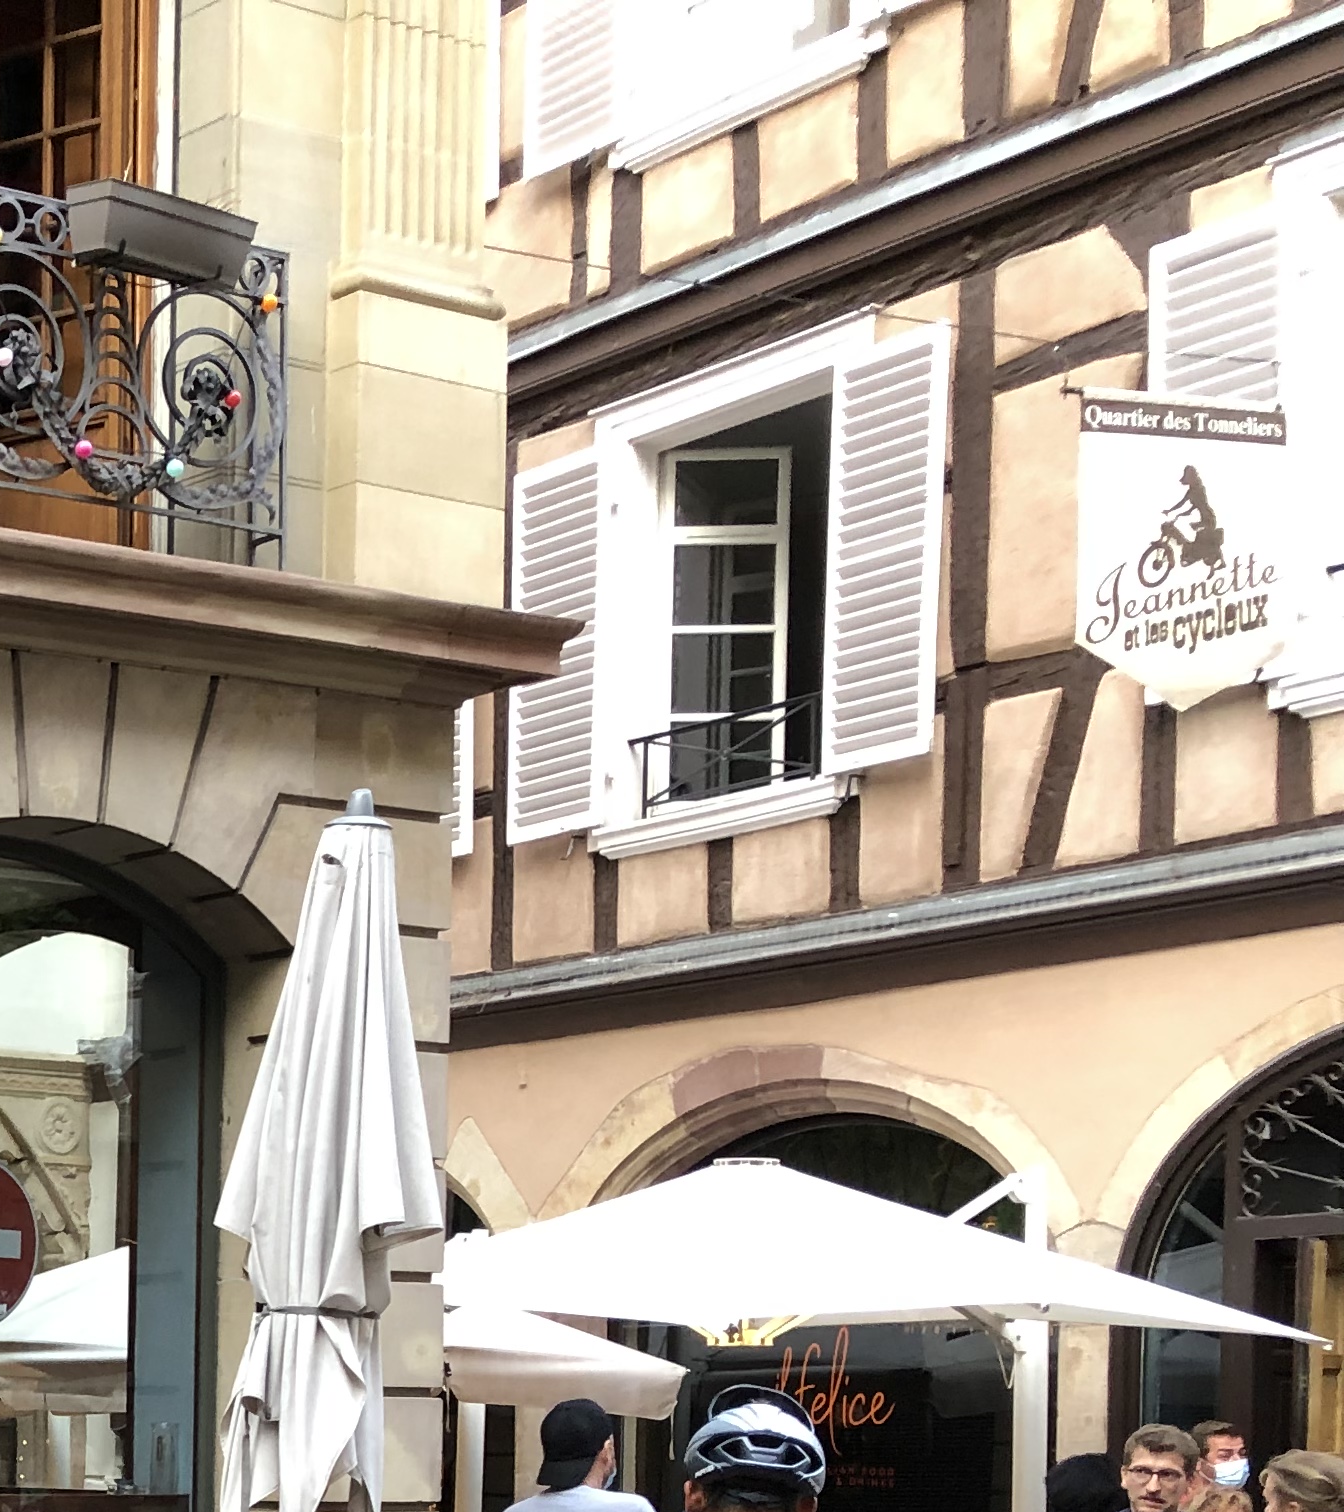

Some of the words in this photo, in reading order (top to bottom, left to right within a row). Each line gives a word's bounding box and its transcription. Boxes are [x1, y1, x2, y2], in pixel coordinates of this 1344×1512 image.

[1084, 404, 1160, 431] Quartier
[1162, 410, 1191, 431] des
[1194, 412, 1283, 438] Tonneliers
[1085, 553, 1278, 644] Jeannette
[1124, 627, 1140, 652] et
[1145, 620, 1168, 647] les
[1172, 594, 1268, 654] cycleux
